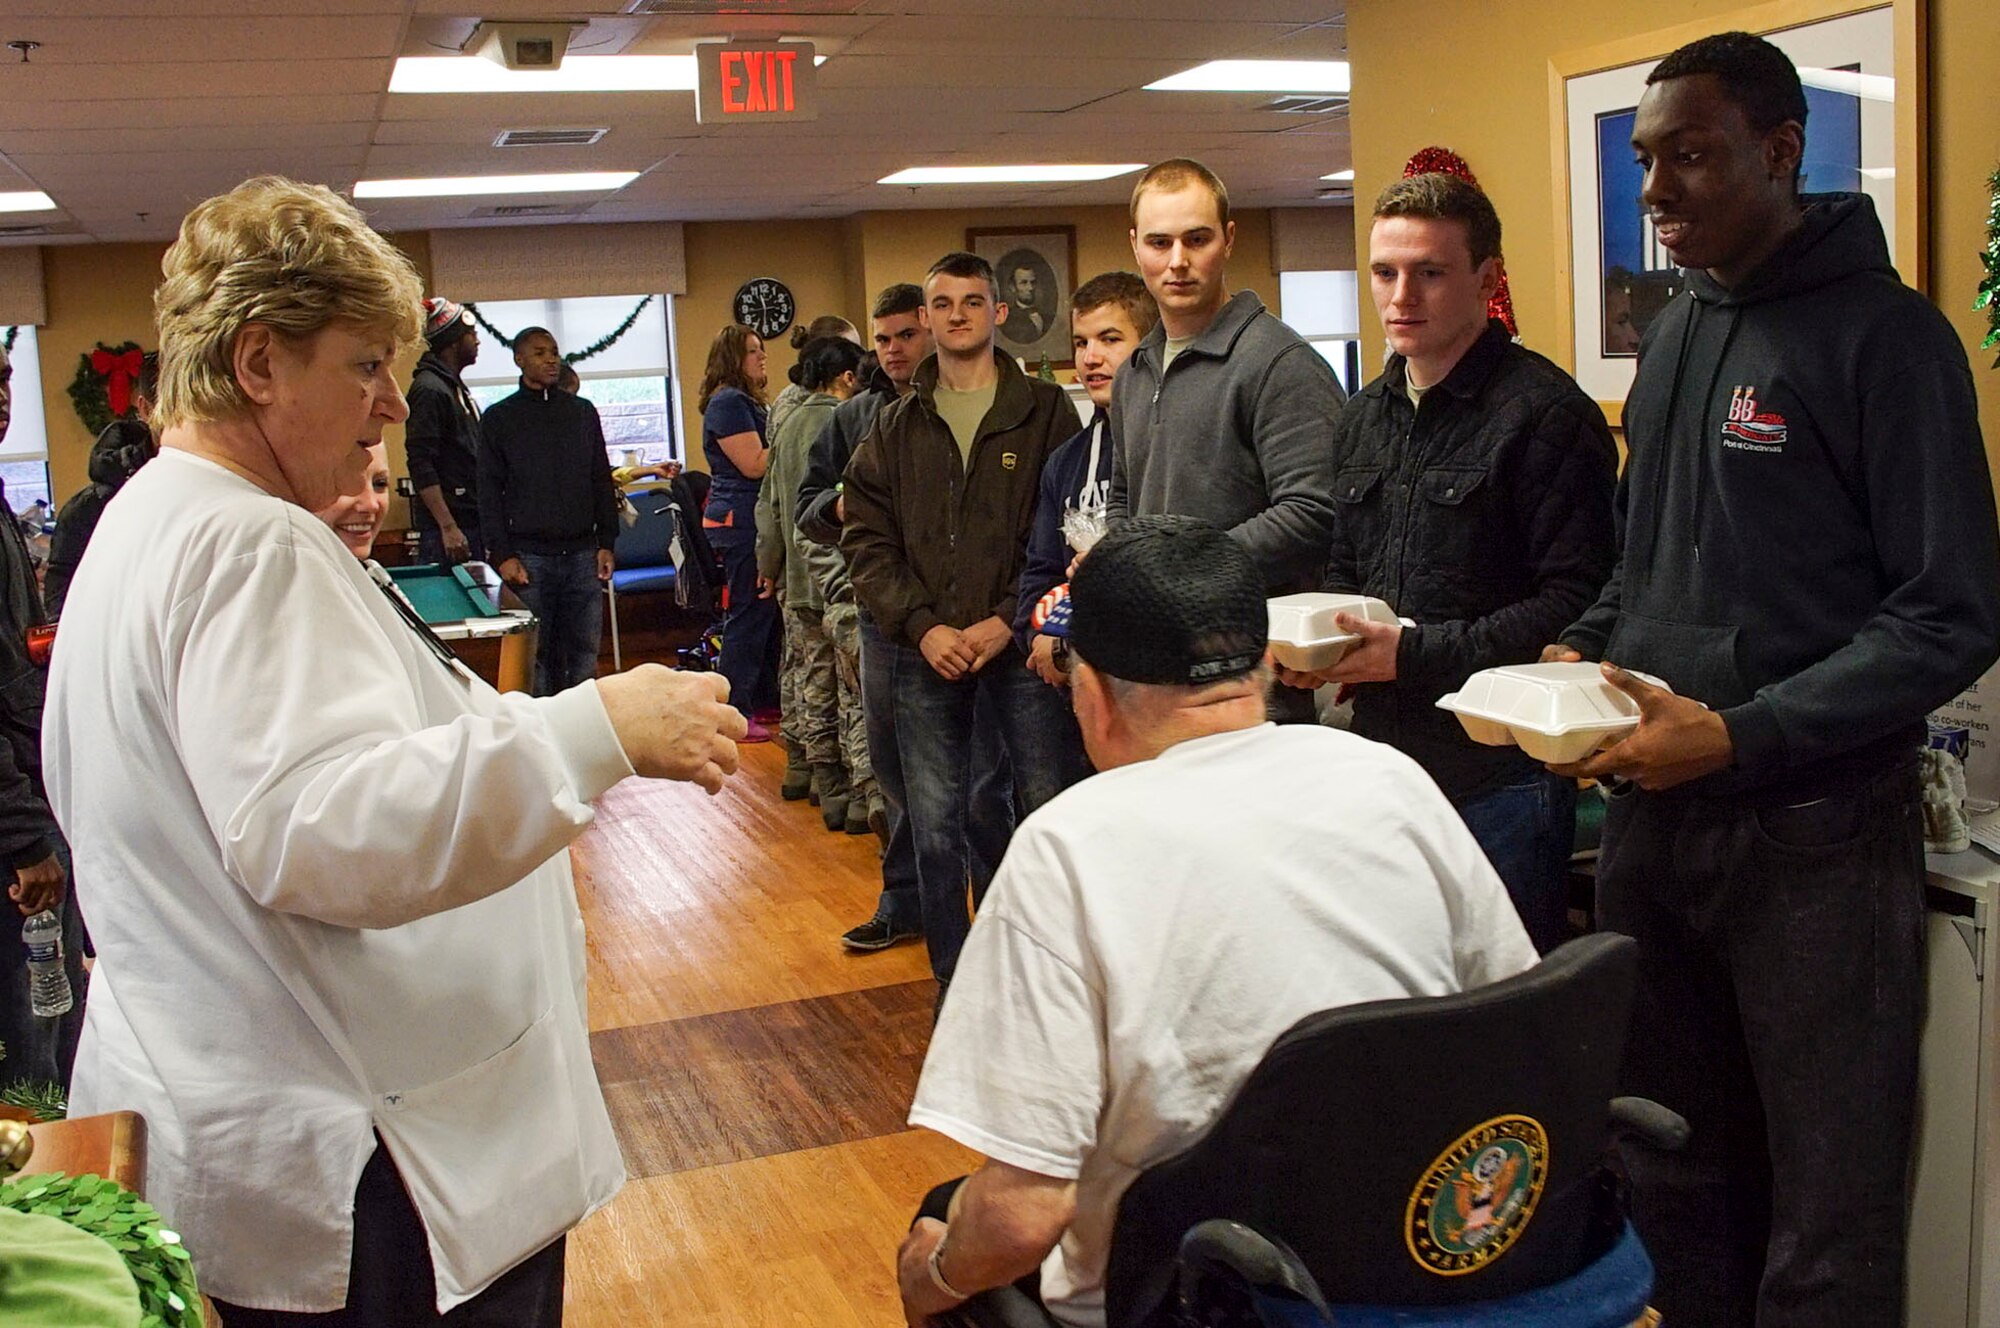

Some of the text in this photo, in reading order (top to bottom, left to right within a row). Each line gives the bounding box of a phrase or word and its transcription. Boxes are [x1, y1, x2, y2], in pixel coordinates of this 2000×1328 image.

[720, 51, 797, 113] EXIT
[759, 283, 769, 293] 12
[771, 286, 776, 296] 1
[742, 294, 753, 304] 10
[778, 293, 785, 303] 2
[781, 303, 787, 313] 3
[745, 314, 752, 325] 8
[752, 322, 759, 331] 7
[1955, 699, 1965, 709] of
[1966, 701, 1982, 712] her
[1941, 716, 1989, 731] co-workers
